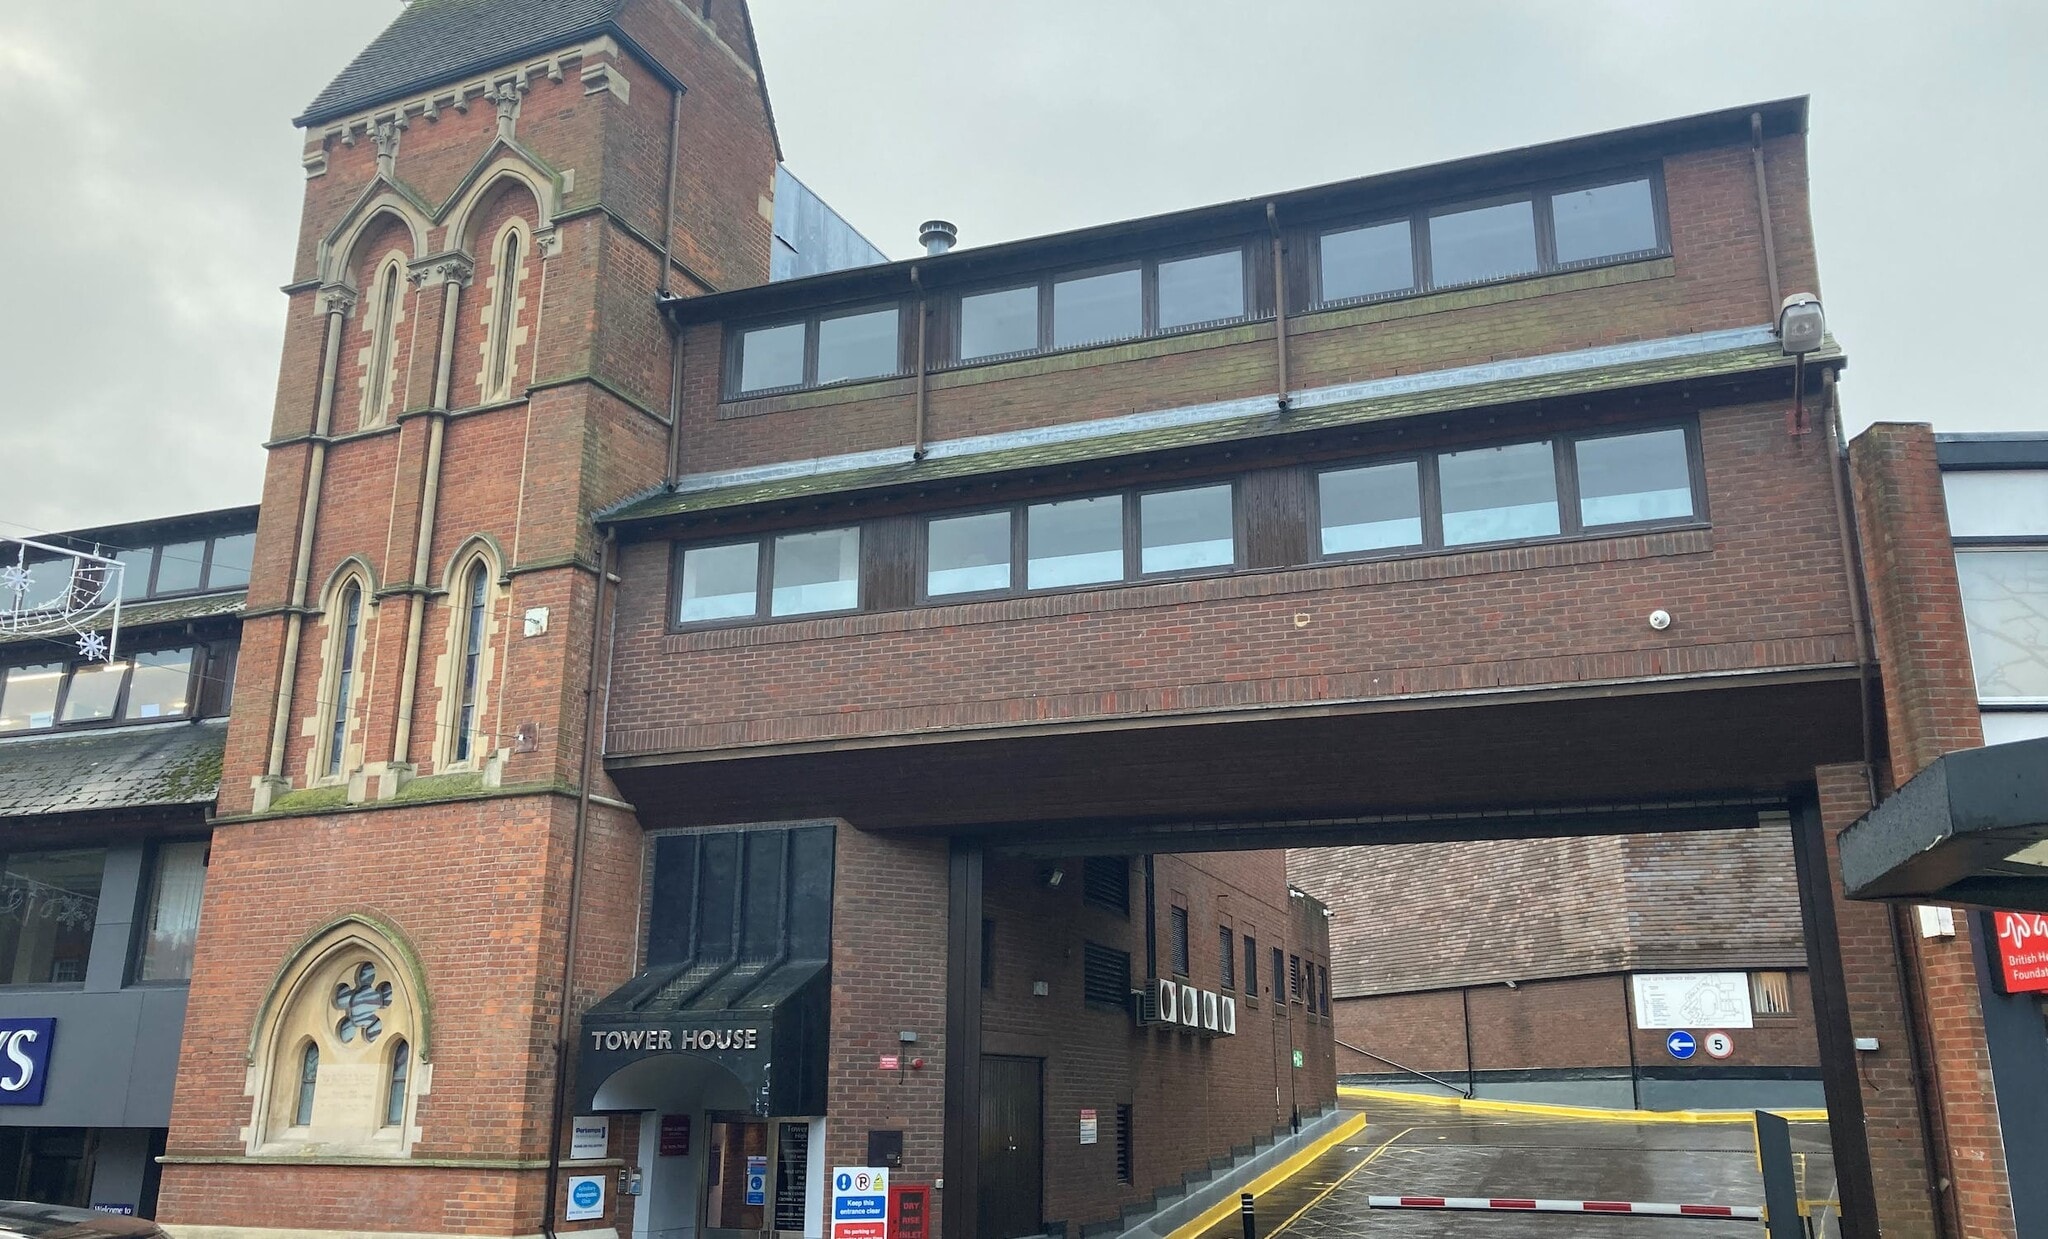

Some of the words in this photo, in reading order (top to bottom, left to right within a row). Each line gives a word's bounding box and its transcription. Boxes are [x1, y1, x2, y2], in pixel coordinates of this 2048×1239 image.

[2009, 953, 2037, 966] British
[592, 1030, 672, 1050] TOWER
[681, 1029, 757, 1050] HOUSE
[1714, 1039, 1723, 1051] 5
[124, 1206, 132, 1214] to
[903, 1202, 919, 1210] DRY
